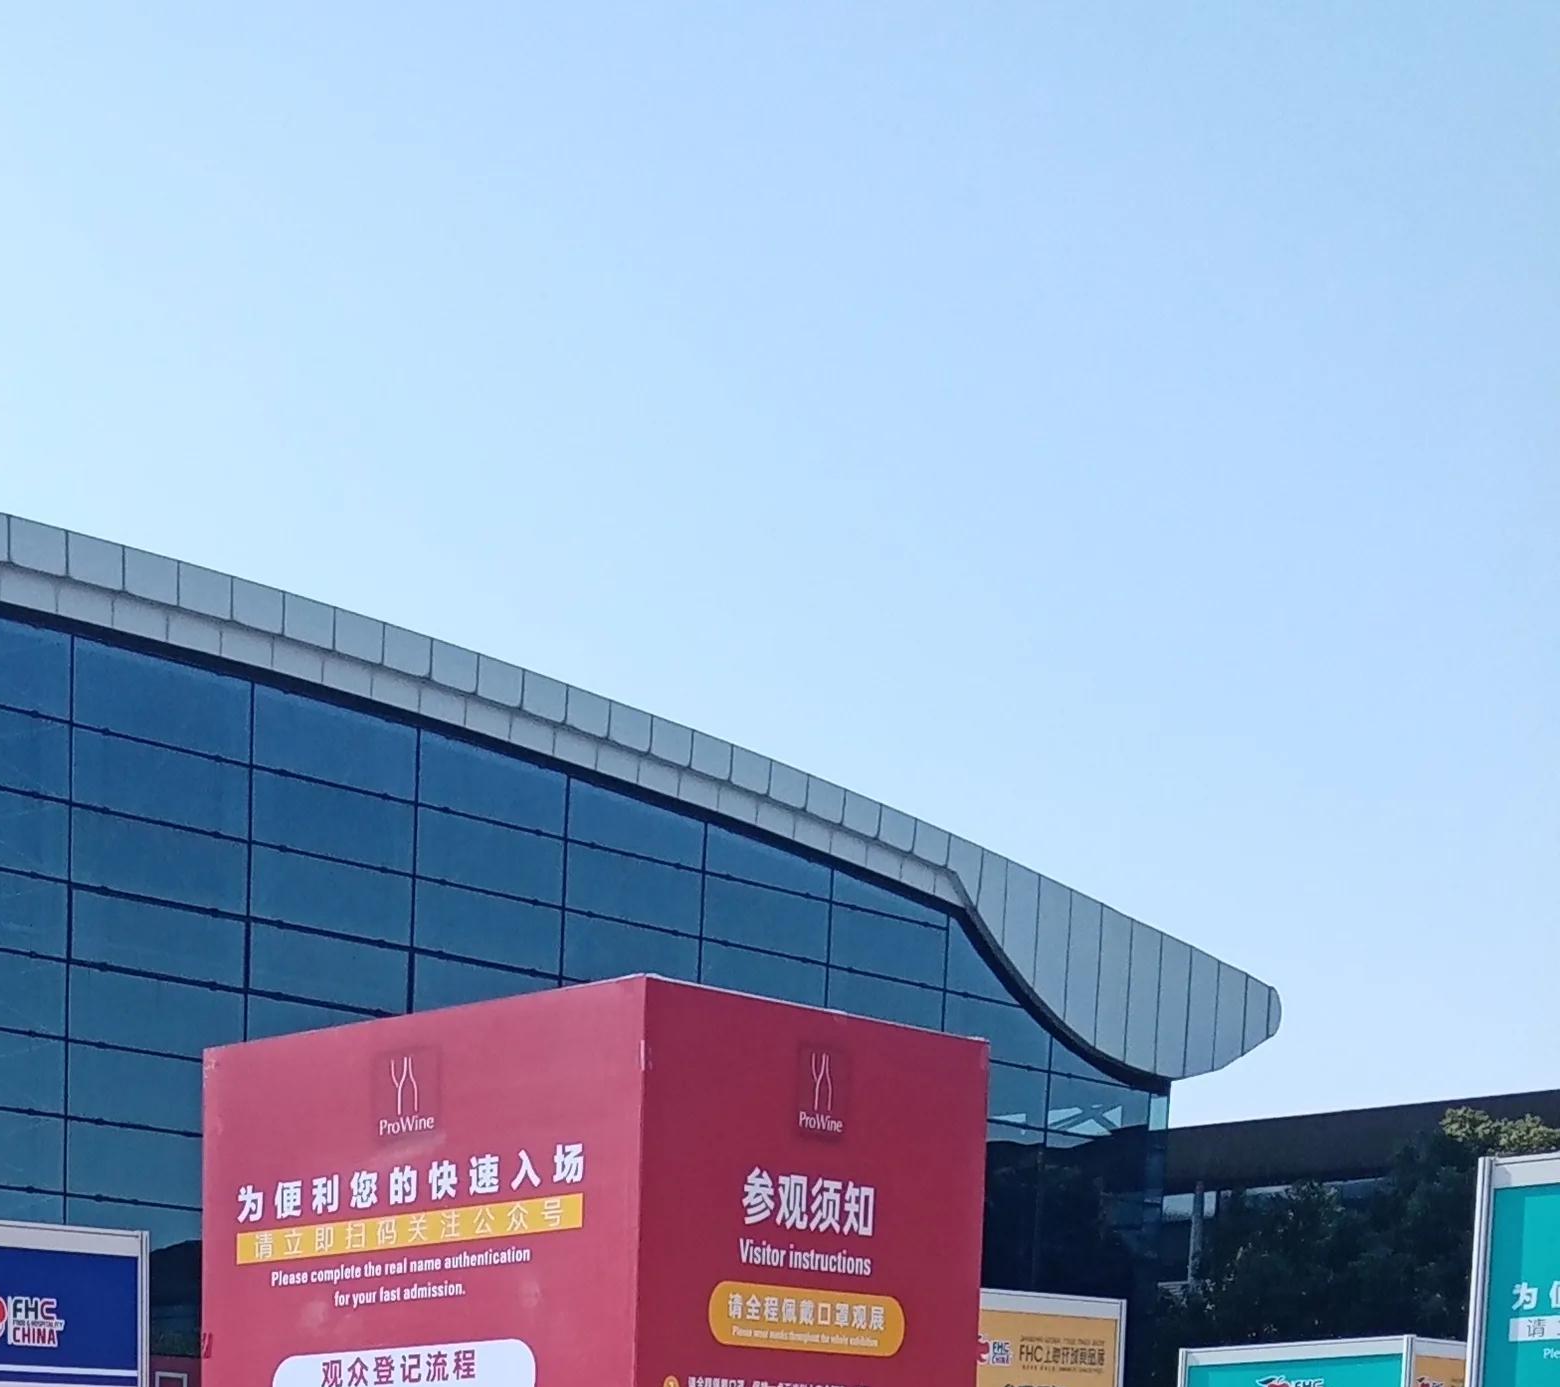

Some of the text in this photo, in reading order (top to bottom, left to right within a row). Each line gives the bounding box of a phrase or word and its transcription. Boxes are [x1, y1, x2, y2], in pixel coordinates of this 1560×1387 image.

[379, 1115, 435, 1136] ProWine
[798, 1111, 843, 1133] ProWine
[237, 1143, 586, 1224] 为便利您的快速入场
[742, 1166, 876, 1237] 参观须知
[254, 1199, 565, 1261] 请立即扫码关注公众号
[271, 1247, 529, 1285] Please complete the real name authentication
[739, 1238, 870, 1274] Visitor instructions
[12, 1299, 56, 1320] FHC
[334, 1281, 466, 1307] for your fast admission.
[727, 1292, 886, 1331] 请全程佩戴口罩观展
[13, 1327, 56, 1345] CHINA
[992, 1341, 1010, 1354] FHC
